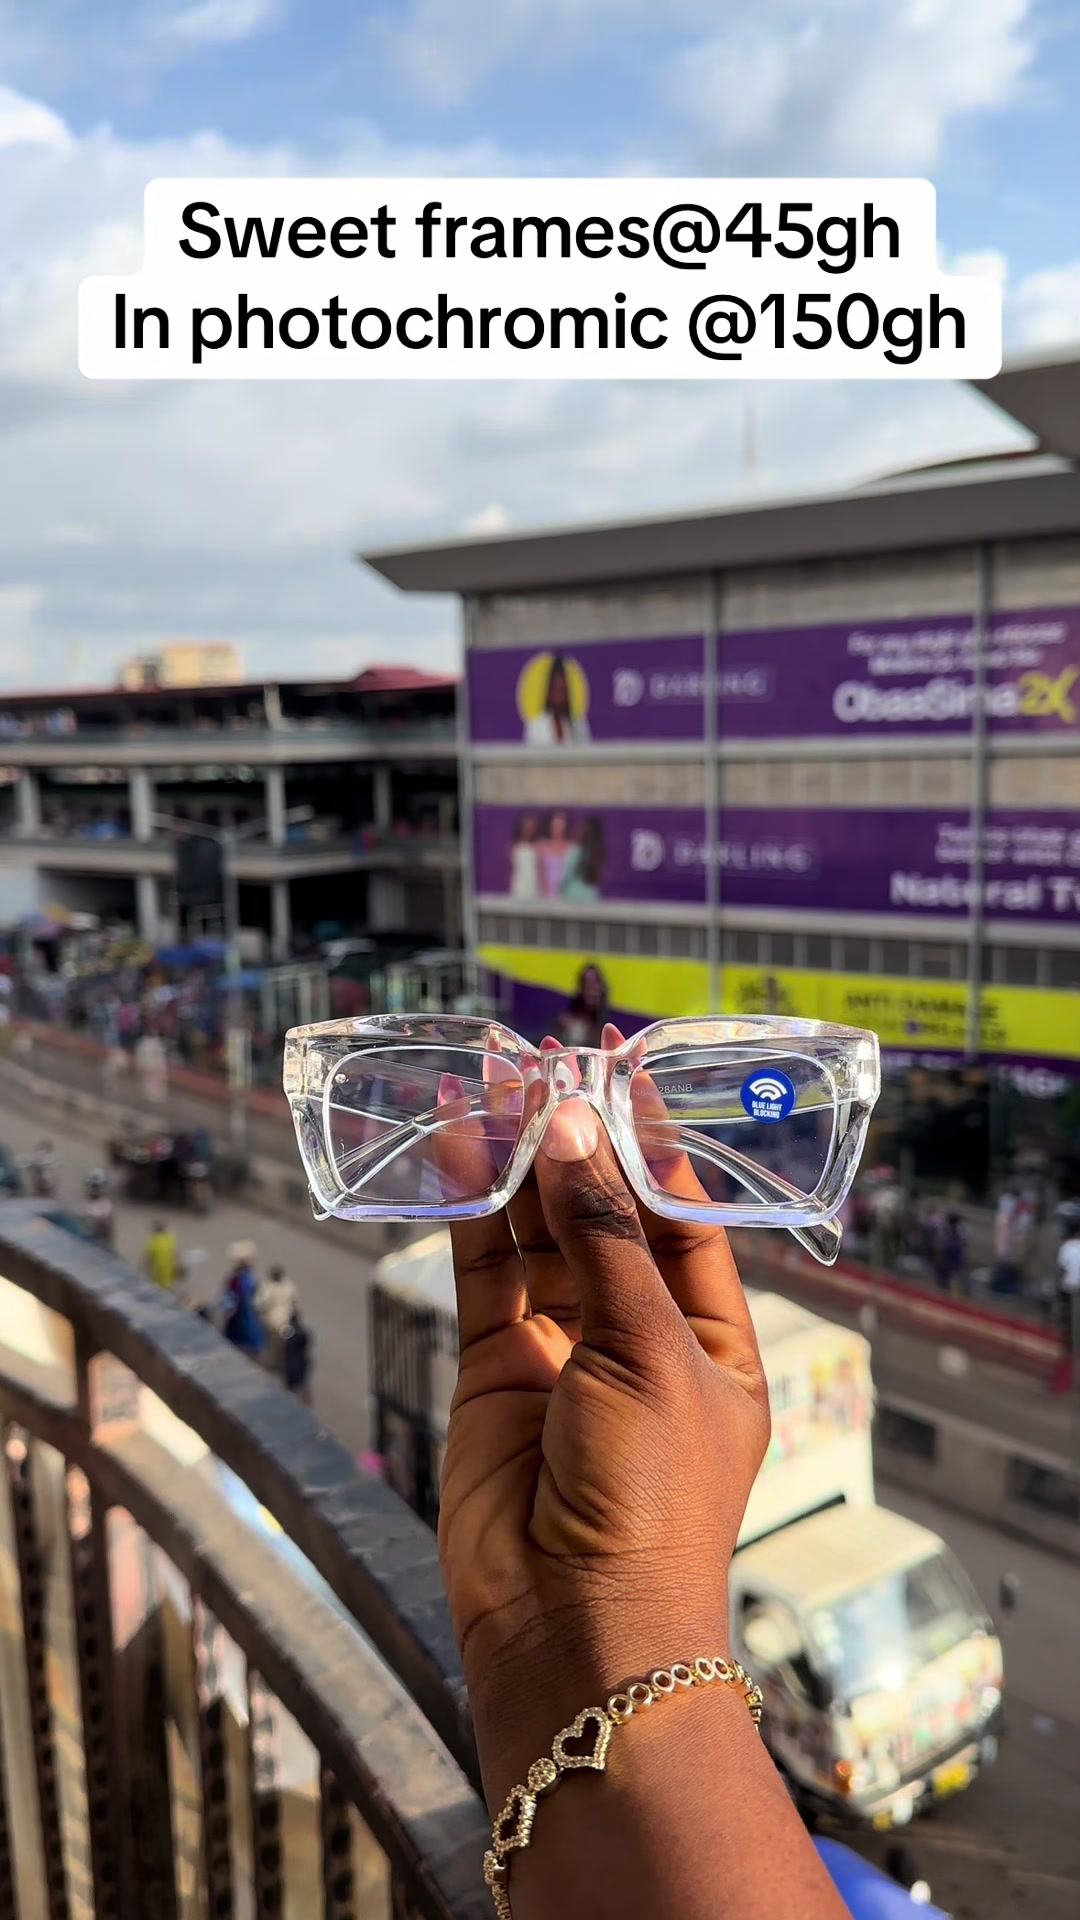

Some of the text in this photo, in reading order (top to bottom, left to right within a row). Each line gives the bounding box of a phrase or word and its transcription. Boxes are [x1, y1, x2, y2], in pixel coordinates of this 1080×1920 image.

[650, 670, 768, 699] DARNG
[906, 992, 998, 1019] DAMAE
[752, 1100, 782, 1111] BLUE LIGHT
[753, 1108, 780, 1119] BLOCKING
